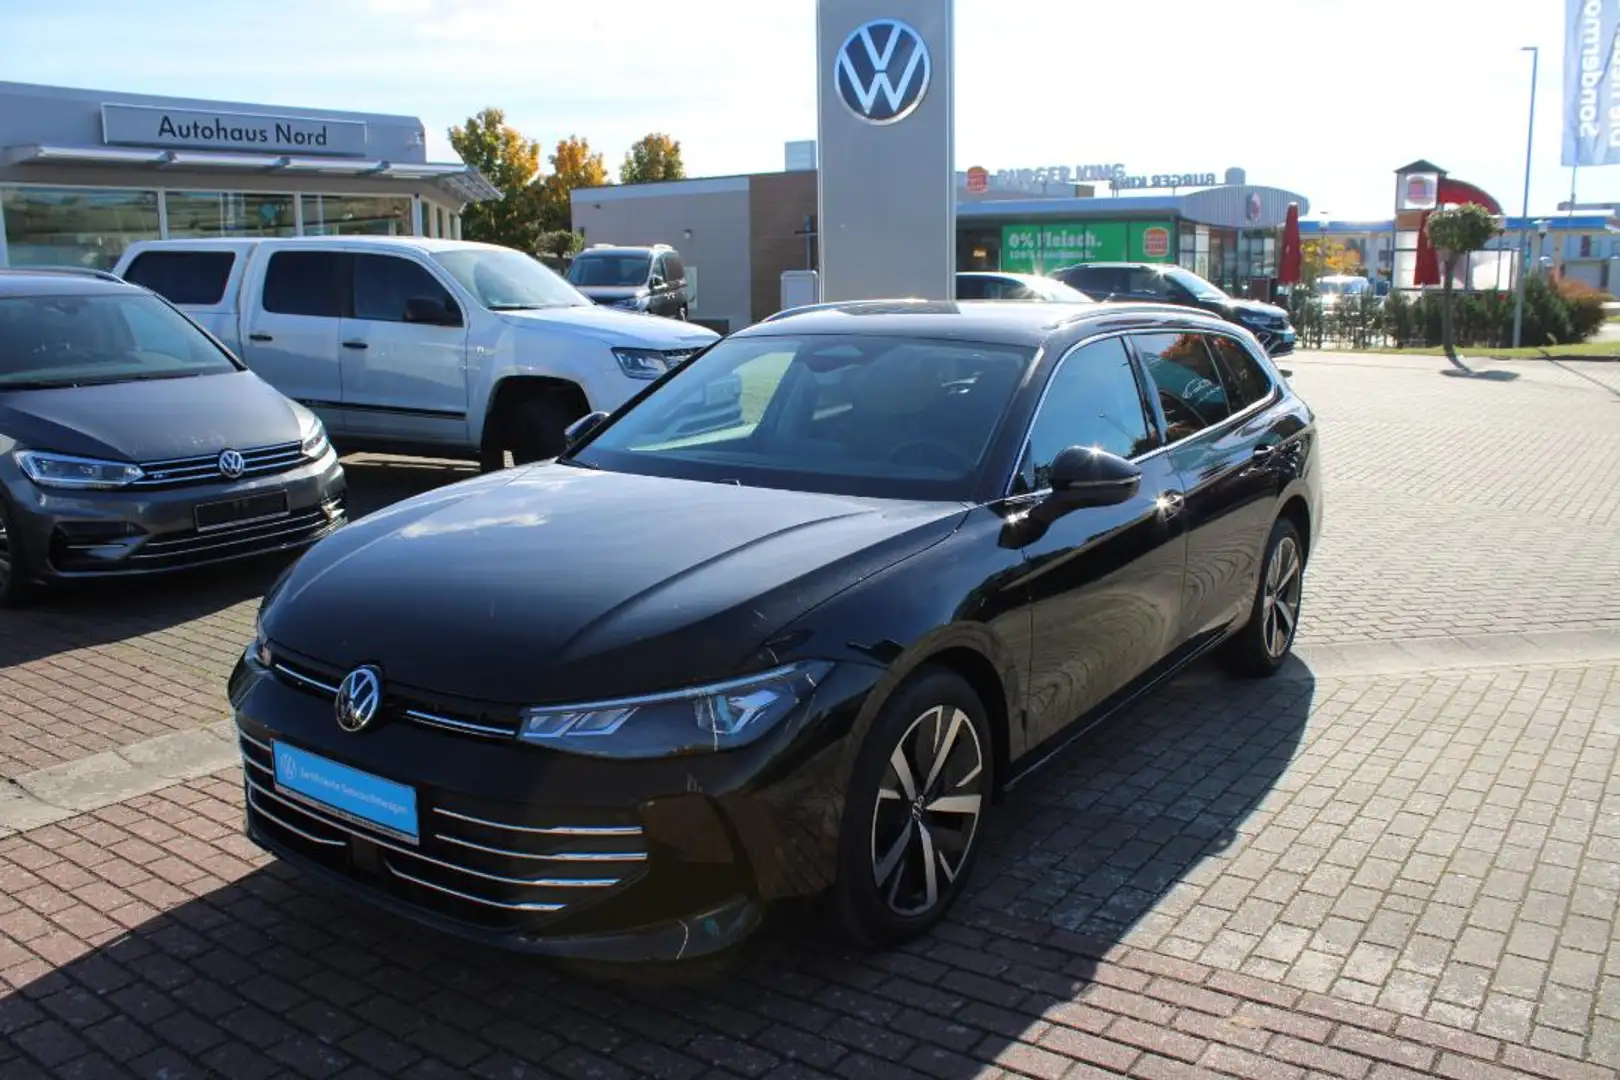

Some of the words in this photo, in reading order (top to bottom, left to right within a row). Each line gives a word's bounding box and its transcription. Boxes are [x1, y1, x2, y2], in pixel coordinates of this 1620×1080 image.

[158, 115, 268, 142] Autohaus
[275, 123, 328, 146] Nord
[1008, 232, 1035, 249] 0%
